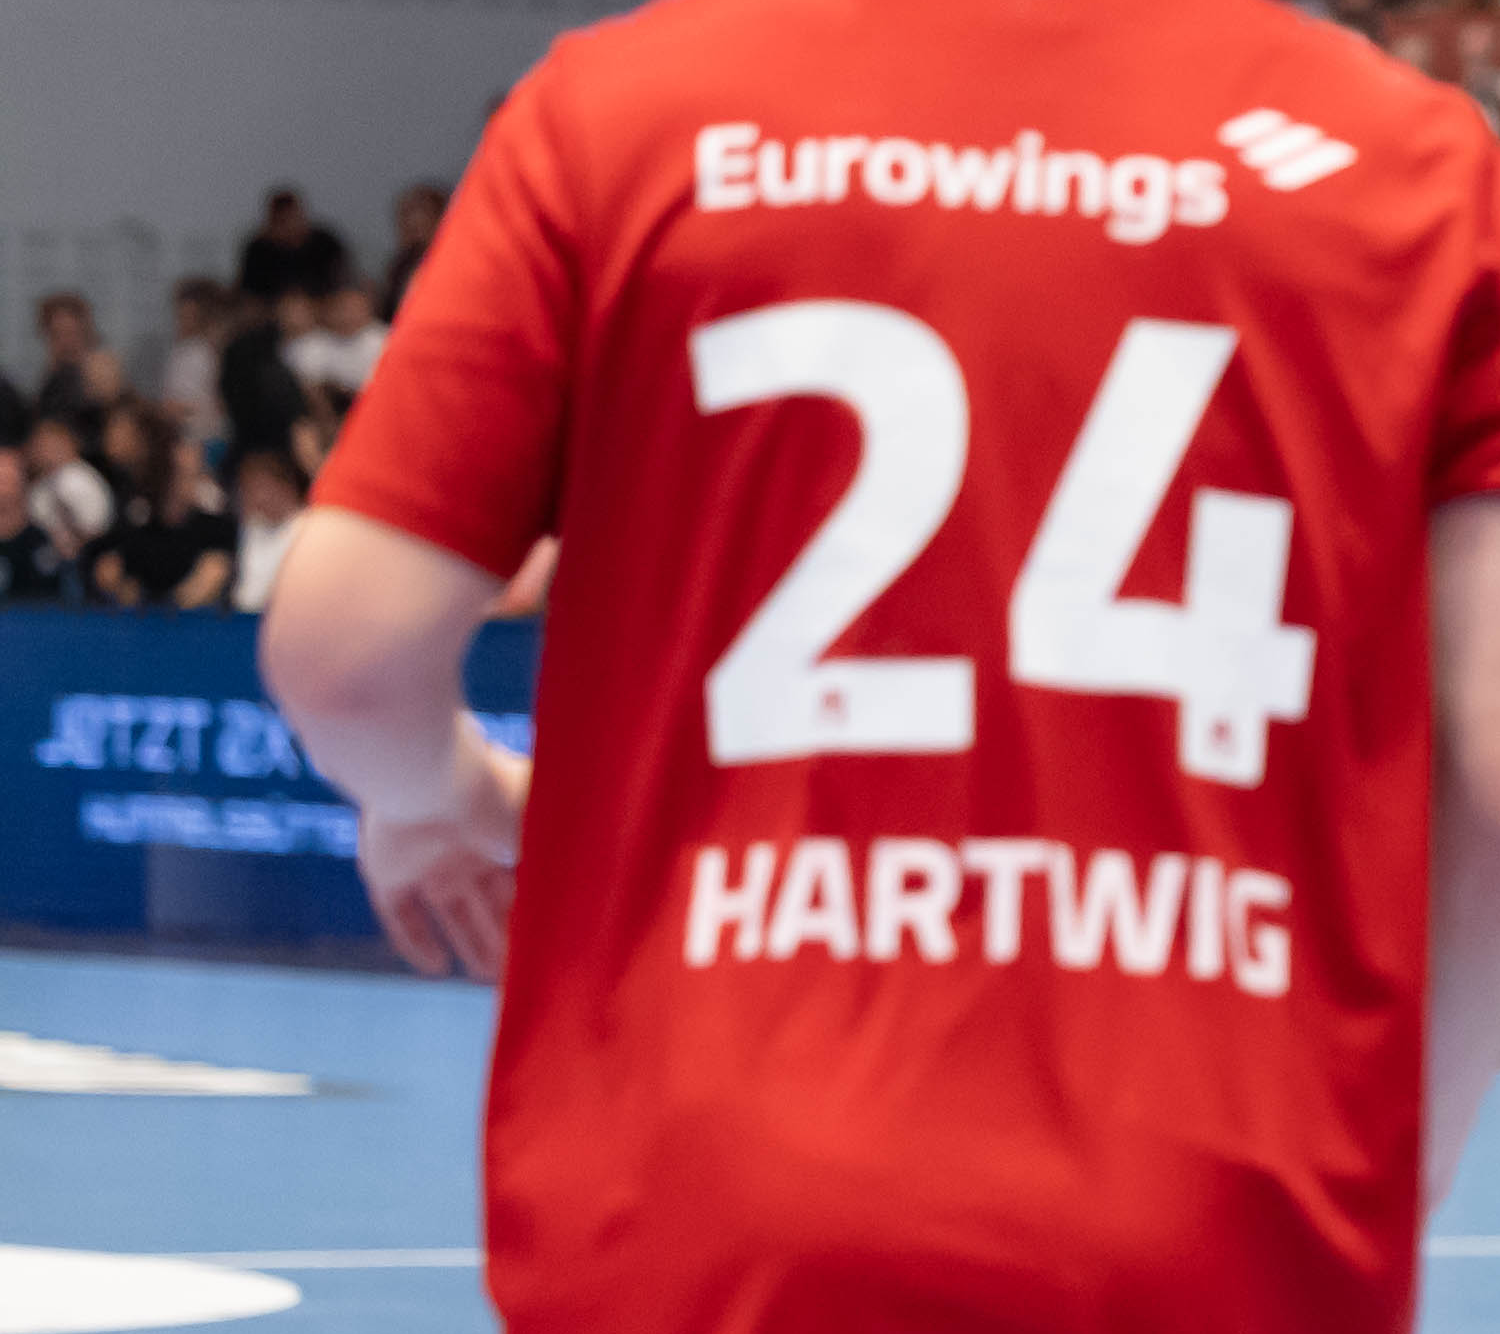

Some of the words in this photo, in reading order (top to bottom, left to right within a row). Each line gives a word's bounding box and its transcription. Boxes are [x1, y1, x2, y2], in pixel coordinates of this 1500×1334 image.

[694, 122, 1228, 244] Eurowings
[689, 299, 1316, 788] 24
[684, 837, 1293, 997] HARTWIG
